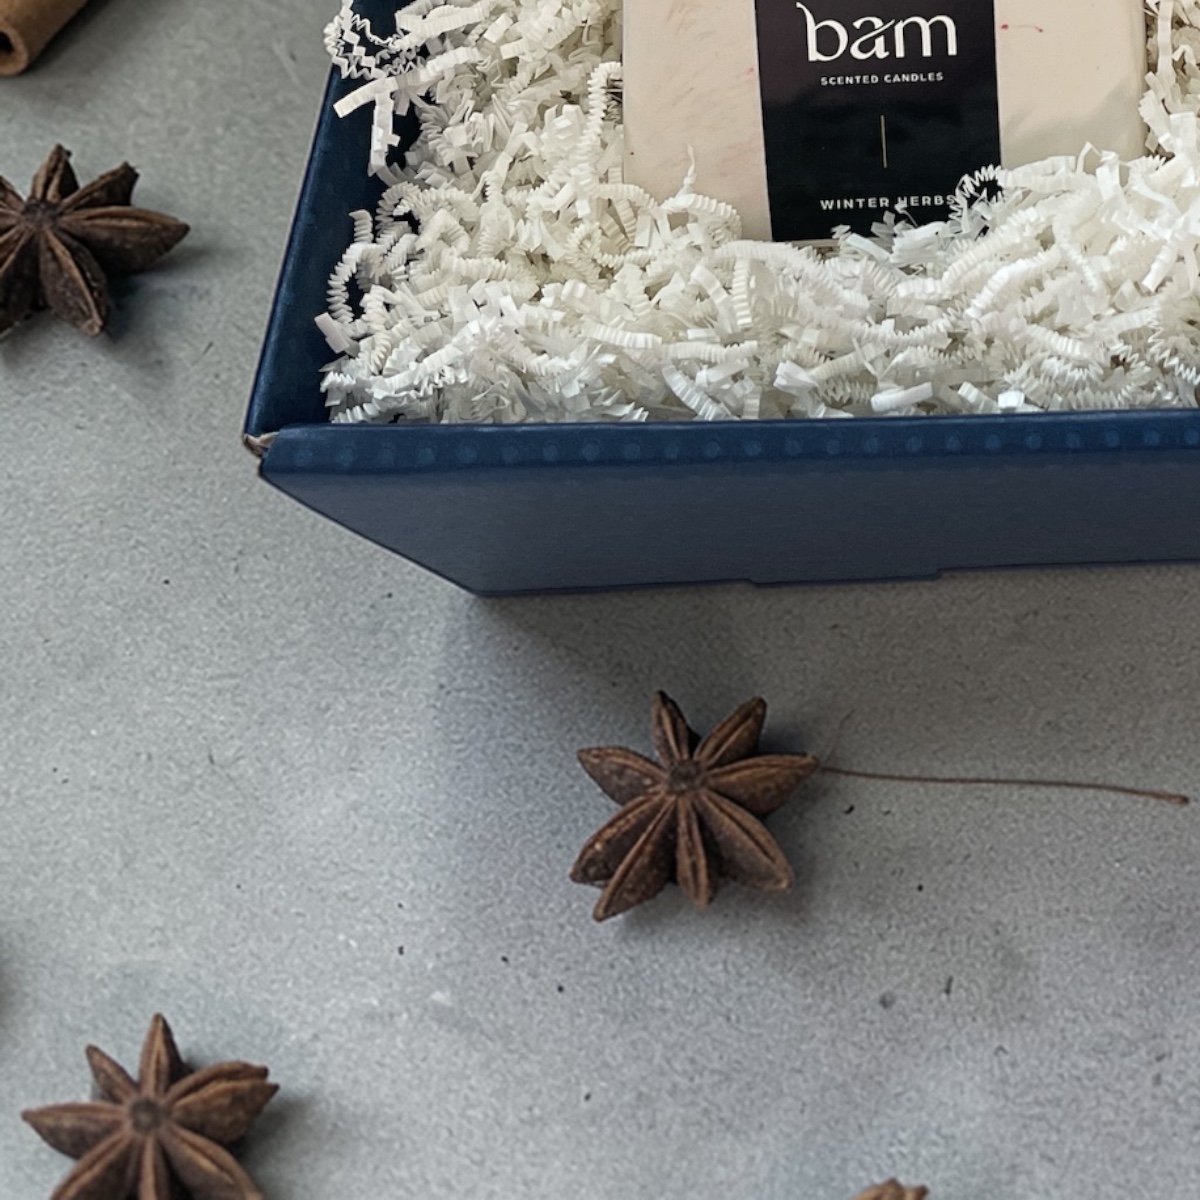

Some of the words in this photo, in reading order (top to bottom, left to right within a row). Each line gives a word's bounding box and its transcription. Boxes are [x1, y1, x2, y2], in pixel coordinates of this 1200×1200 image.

[796, 2, 957, 62] bam
[820, 75, 879, 87] SCENTED
[883, 71, 944, 84] CANDLES
[820, 196, 890, 211] WINTER
